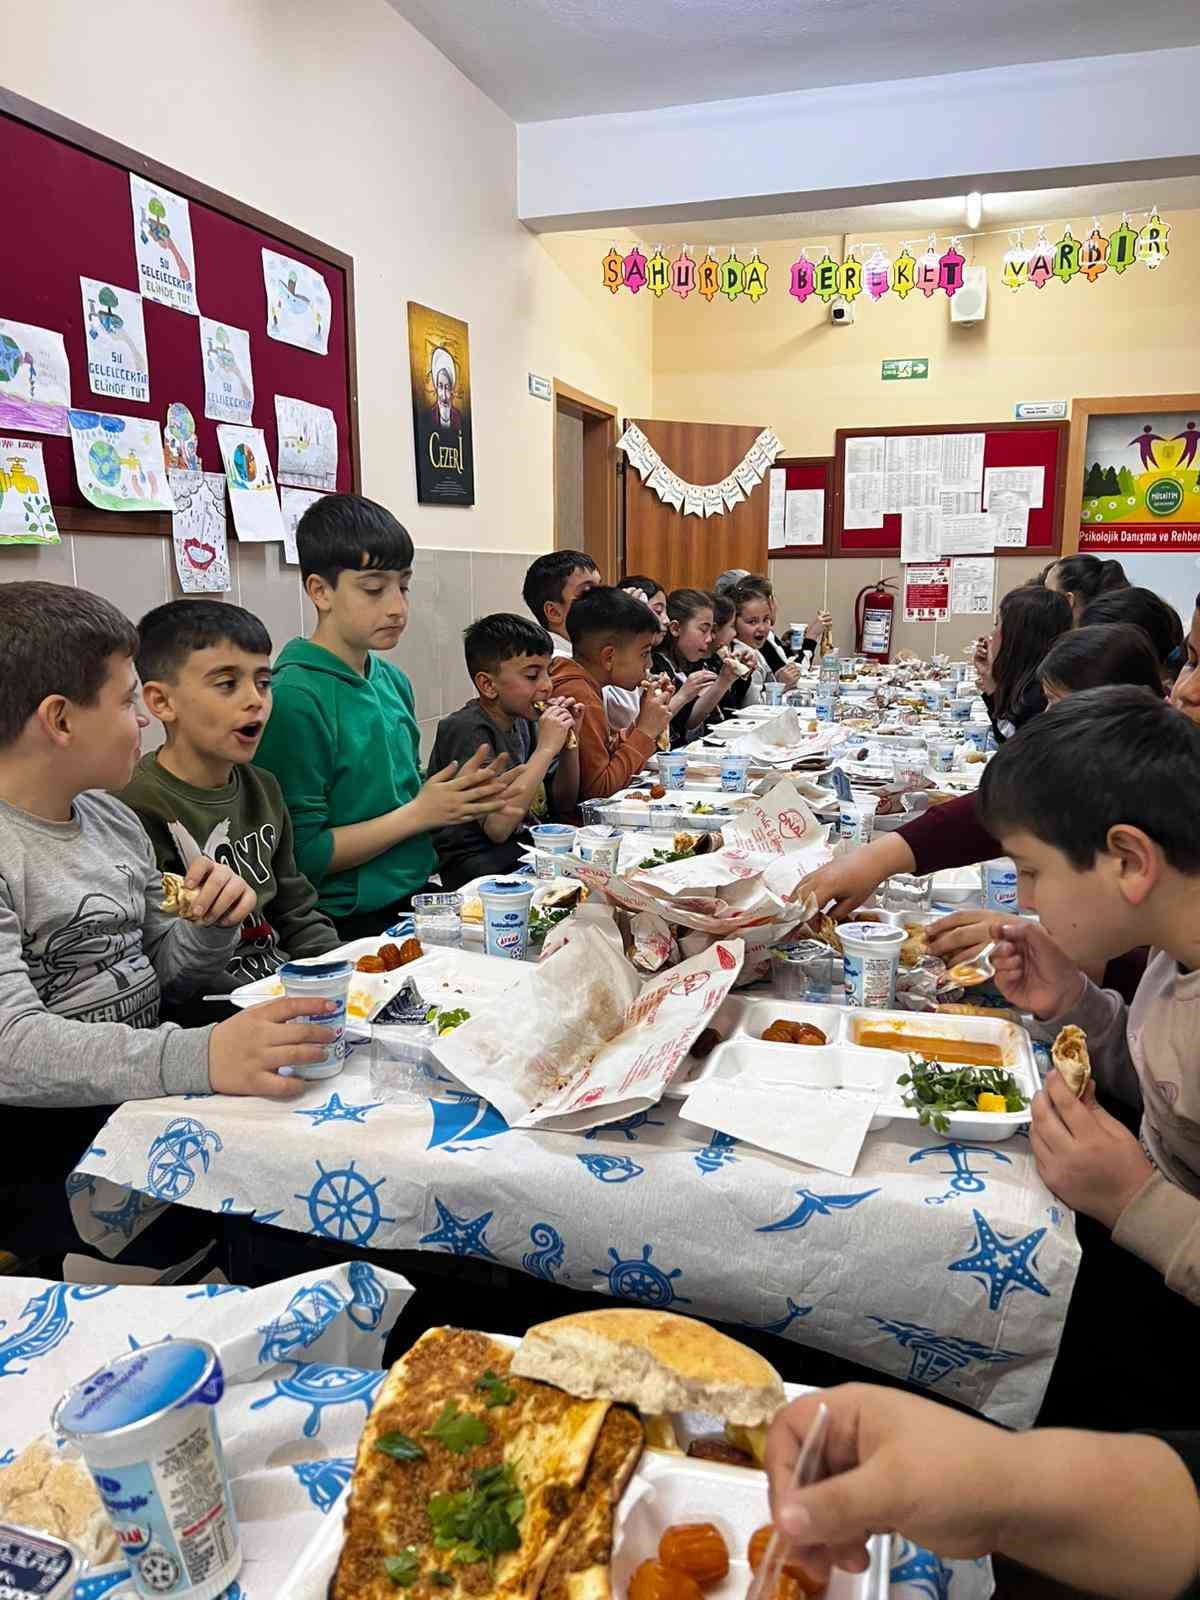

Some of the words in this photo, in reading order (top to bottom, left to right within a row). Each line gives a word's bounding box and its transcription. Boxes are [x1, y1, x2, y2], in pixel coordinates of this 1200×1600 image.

[159, 256, 169, 270] SU
[607, 258, 763, 290] SAHURDA
[797, 263, 960, 290] BEREKET
[1010, 228, 1161, 277] VARDIR
[111, 351, 122, 364] SU
[130, 386, 145, 399] TUT
[1079, 530, 1119, 544] Psikolojik
[1120, 530, 1157, 545] Danışma
[1159, 533, 1169, 542] ve
